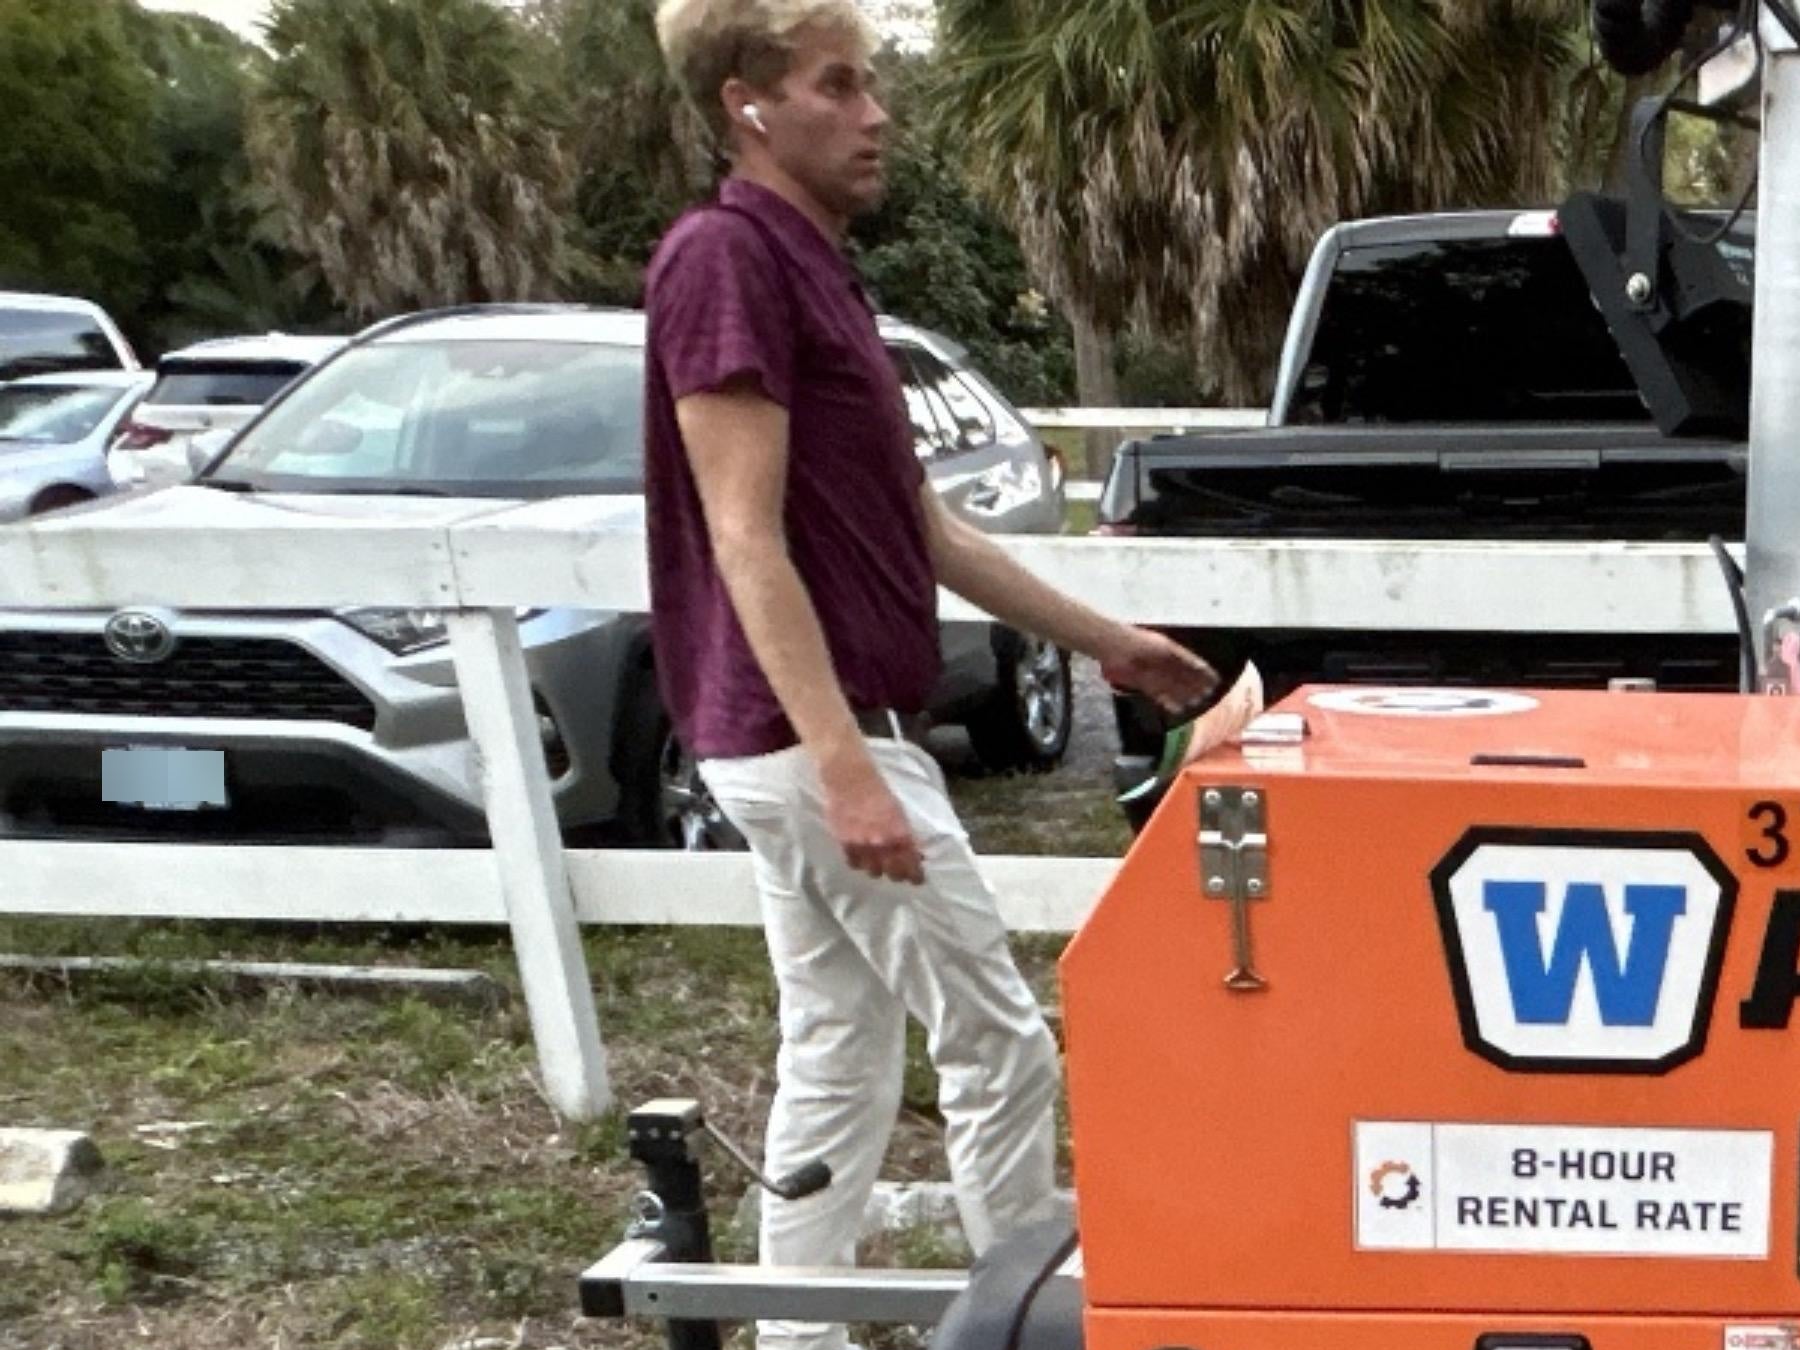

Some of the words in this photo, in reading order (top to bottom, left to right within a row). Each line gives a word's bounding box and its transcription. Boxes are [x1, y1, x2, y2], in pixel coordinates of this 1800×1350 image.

[1511, 1147, 1676, 1182] 8-HOUR
[1456, 1196, 1618, 1229] RENTAL
[1635, 1200, 1742, 1233] RATE
